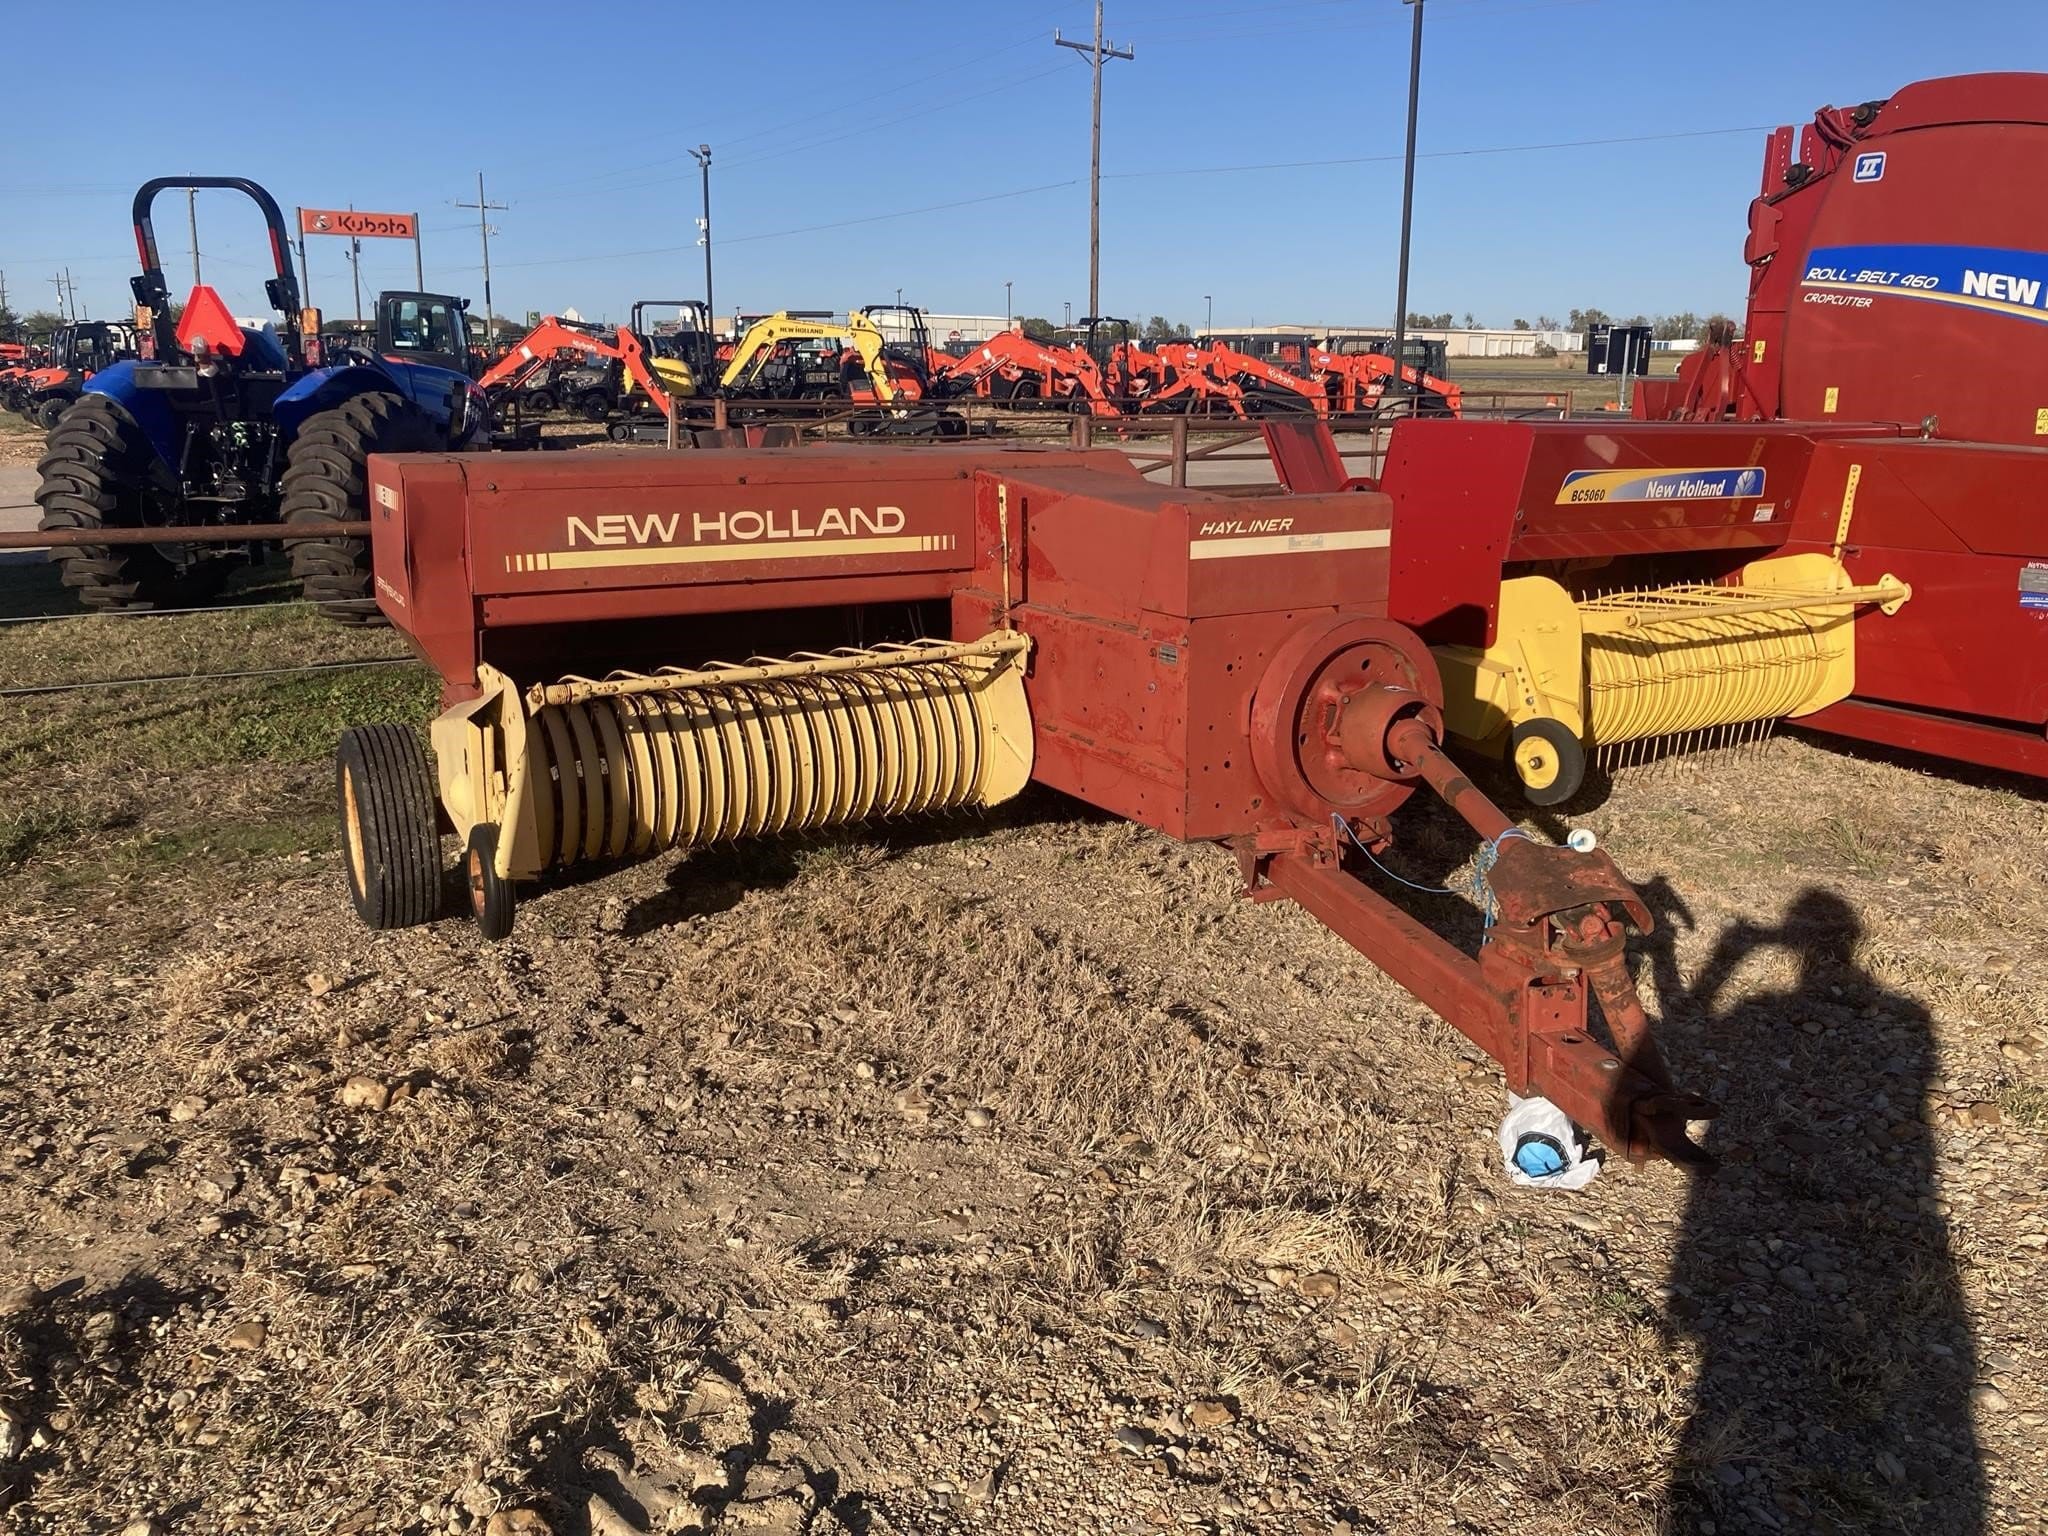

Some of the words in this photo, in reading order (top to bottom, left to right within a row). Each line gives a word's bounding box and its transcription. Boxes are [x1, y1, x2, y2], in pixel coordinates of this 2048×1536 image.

[338, 215, 408, 234] Kubota
[1900, 274, 1940, 289] 460
[1962, 269, 2041, 306] NEW
[1803, 292, 1873, 308] CROPCUTTER
[1571, 489, 1605, 502] BC5060
[1645, 481, 1675, 498] New
[1677, 479, 1727, 497] Holland
[566, 512, 680, 546] NEW
[693, 506, 906, 541] HOLLAND
[1200, 517, 1294, 536] HAYLINER
